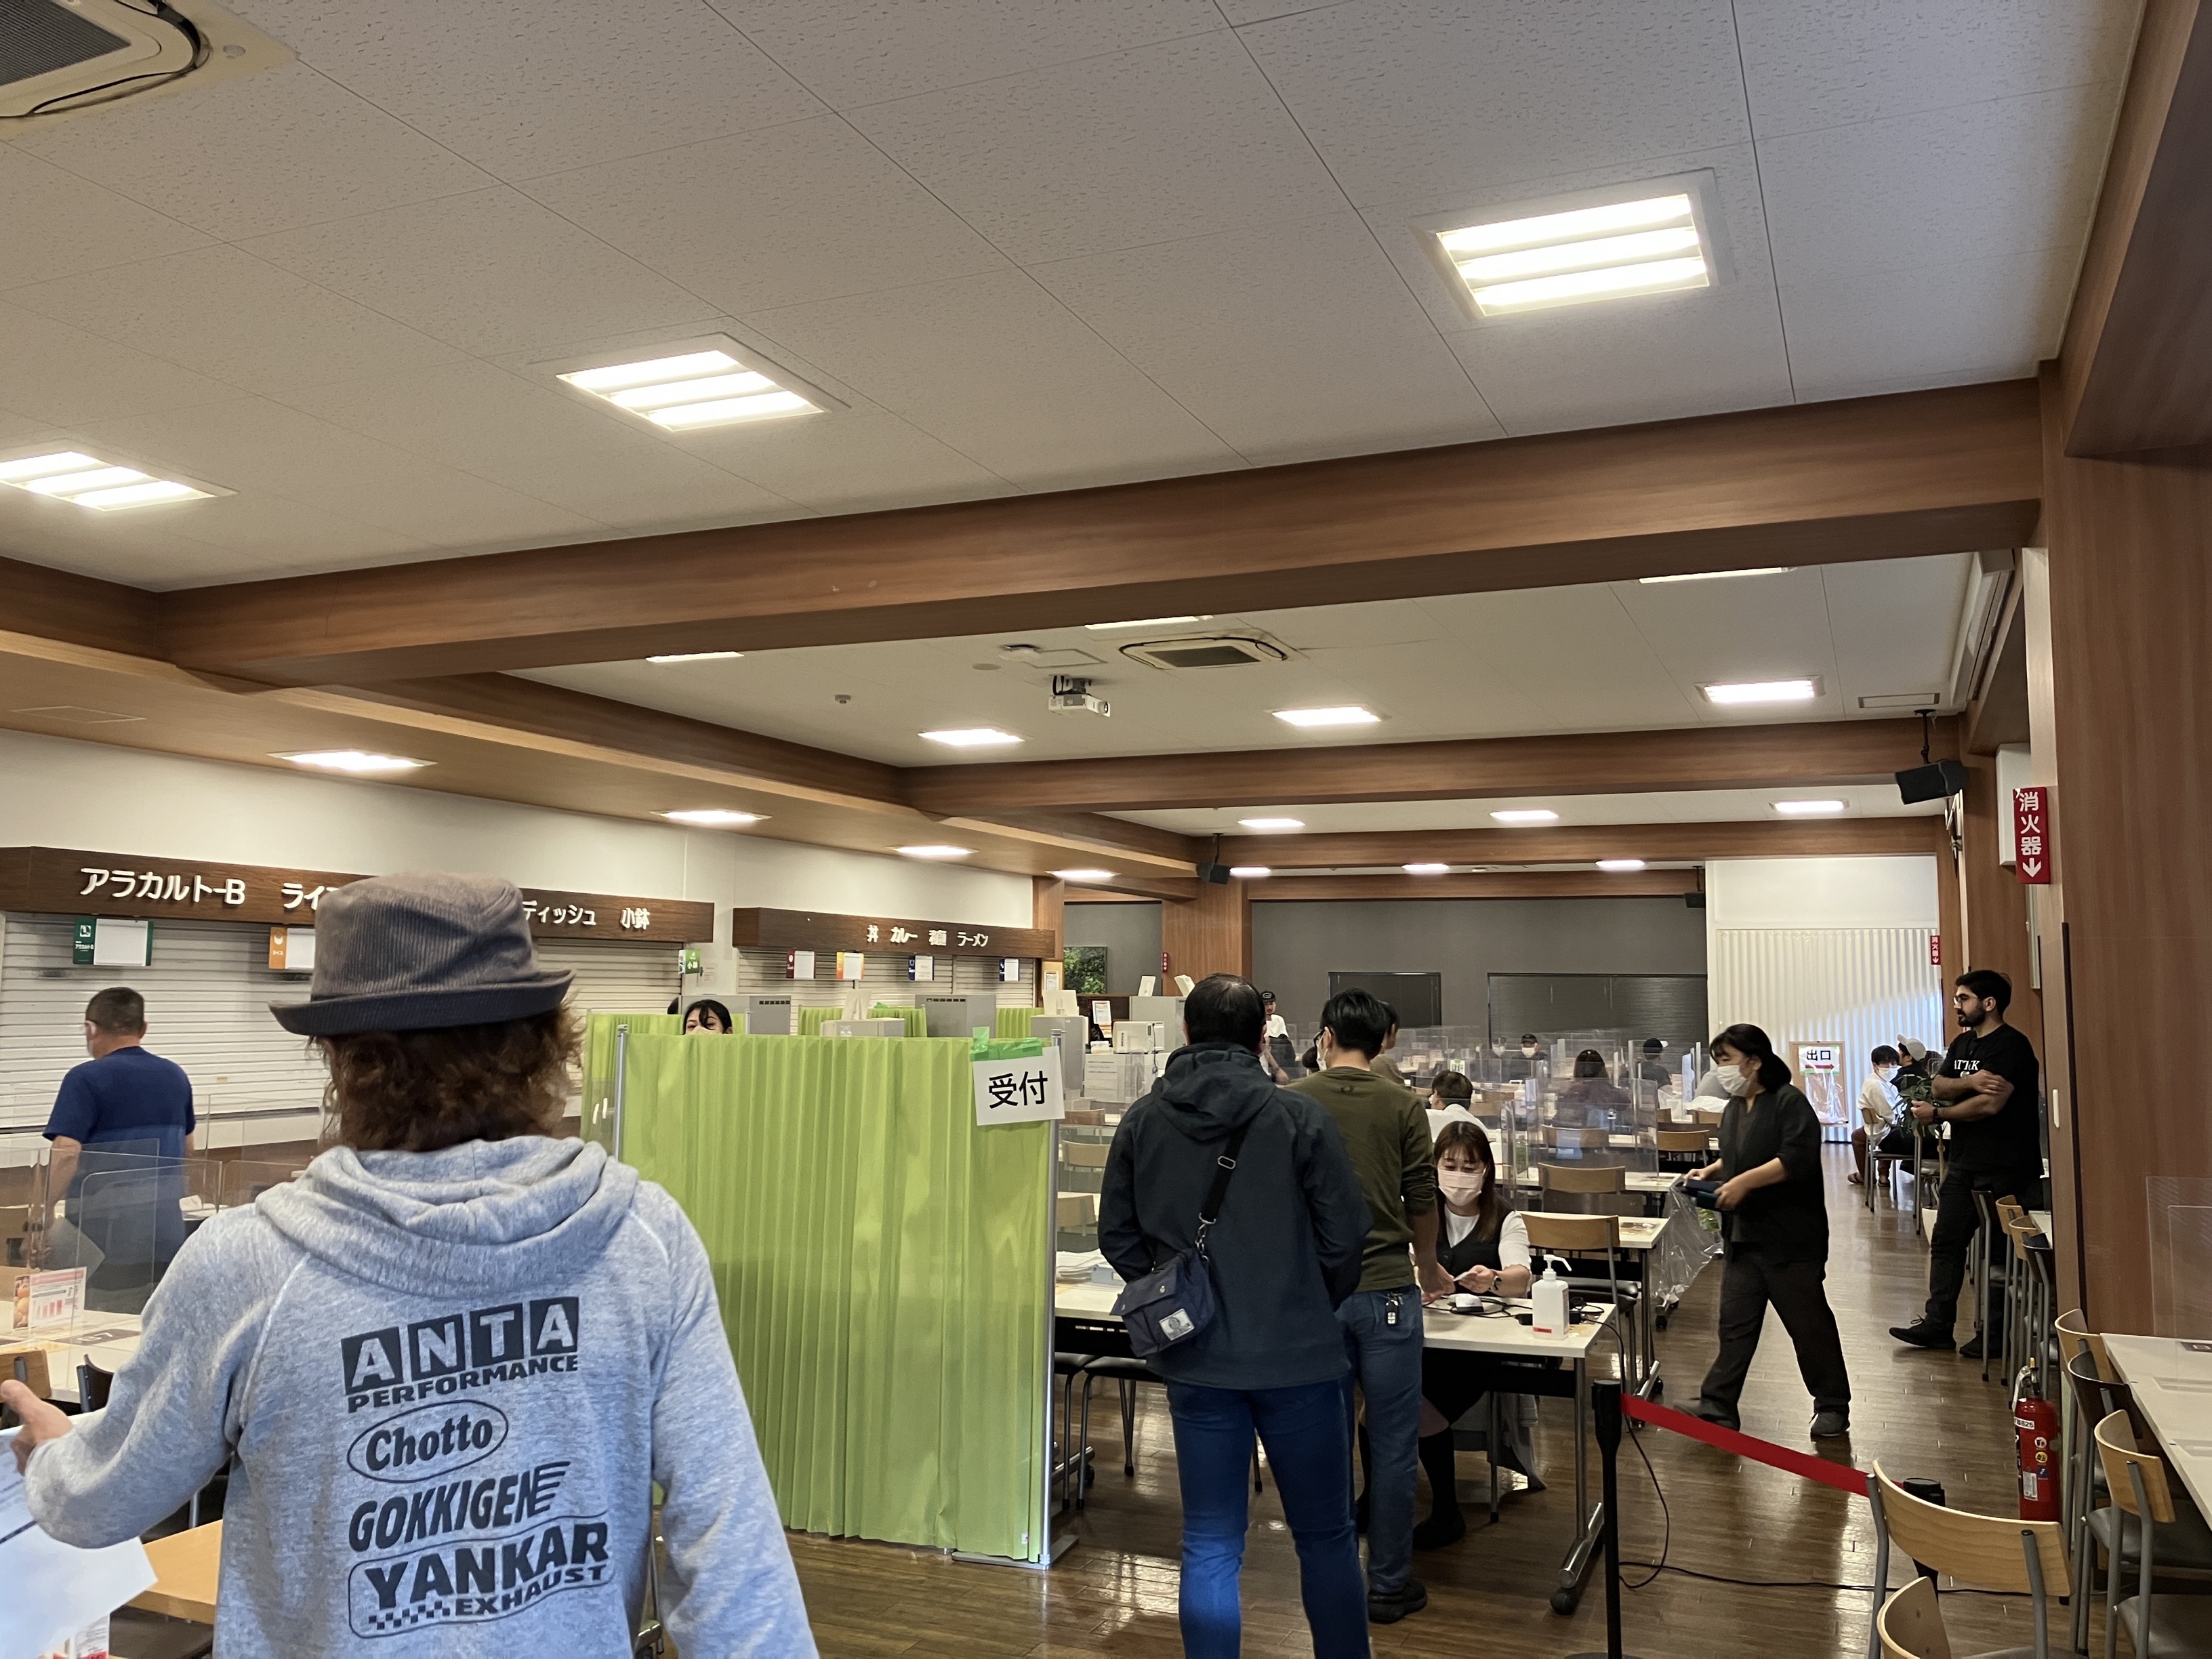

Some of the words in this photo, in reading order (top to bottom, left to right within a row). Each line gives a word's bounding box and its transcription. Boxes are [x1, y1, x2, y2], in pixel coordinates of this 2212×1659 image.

[2019, 791, 2042, 856] 消火器
[620, 907, 651, 930] 小鉢
[867, 925, 879, 943] 丼
[890, 926, 918, 944] カレー
[957, 932, 989, 947] ラーメン
[1806, 1049, 1831, 1061] 出口
[989, 1070, 1048, 1109] 受付
[344, 1298, 578, 1392] ANTA
[348, 1355, 578, 1413] PERFORMANCE
[365, 1414, 493, 1472] Chotto
[364, 1521, 609, 1611] YANKAR
[455, 1563, 608, 1616] EXHAUST
